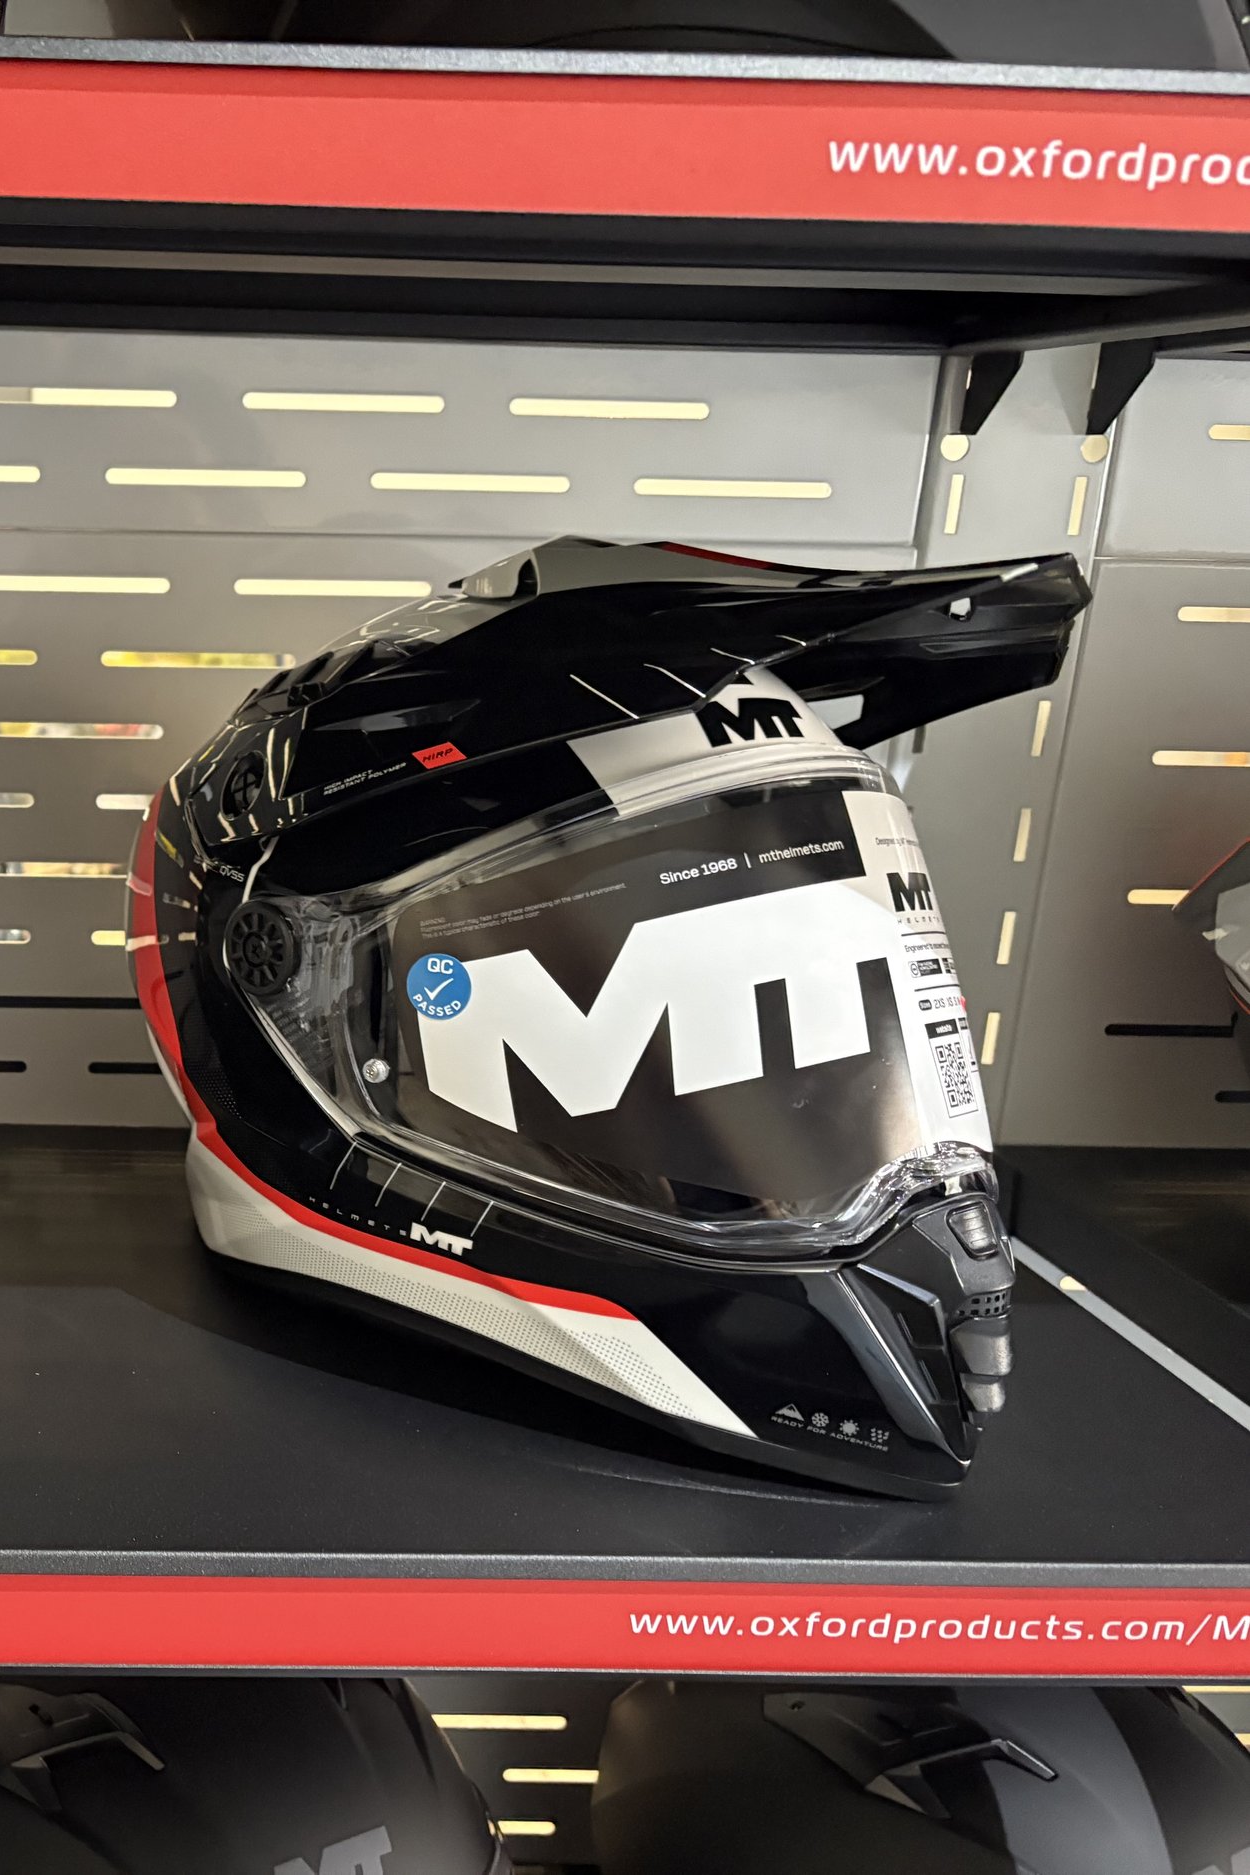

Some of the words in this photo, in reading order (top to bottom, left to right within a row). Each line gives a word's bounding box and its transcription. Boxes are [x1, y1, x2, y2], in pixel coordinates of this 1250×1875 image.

[696, 697, 804, 748] MT
[422, 747, 454, 763] HIRP
[323, 777, 366, 796] RESISTANT
[368, 762, 407, 779] POLYMER
[659, 868, 700, 885] Since
[700, 858, 738, 876] 1968
[758, 839, 845, 864] mthelmets.com
[427, 957, 454, 974] QC
[413, 993, 461, 1017] PASSED
[417, 876, 887, 1132] MT
[410, 1222, 474, 1256] MT
[770, 1416, 804, 1428] READY
[807, 1425, 827, 1435] FOR
[830, 1432, 888, 1452] ADVENTURE
[629, 1611, 1250, 1646] www.oxfordproducts.com/M
